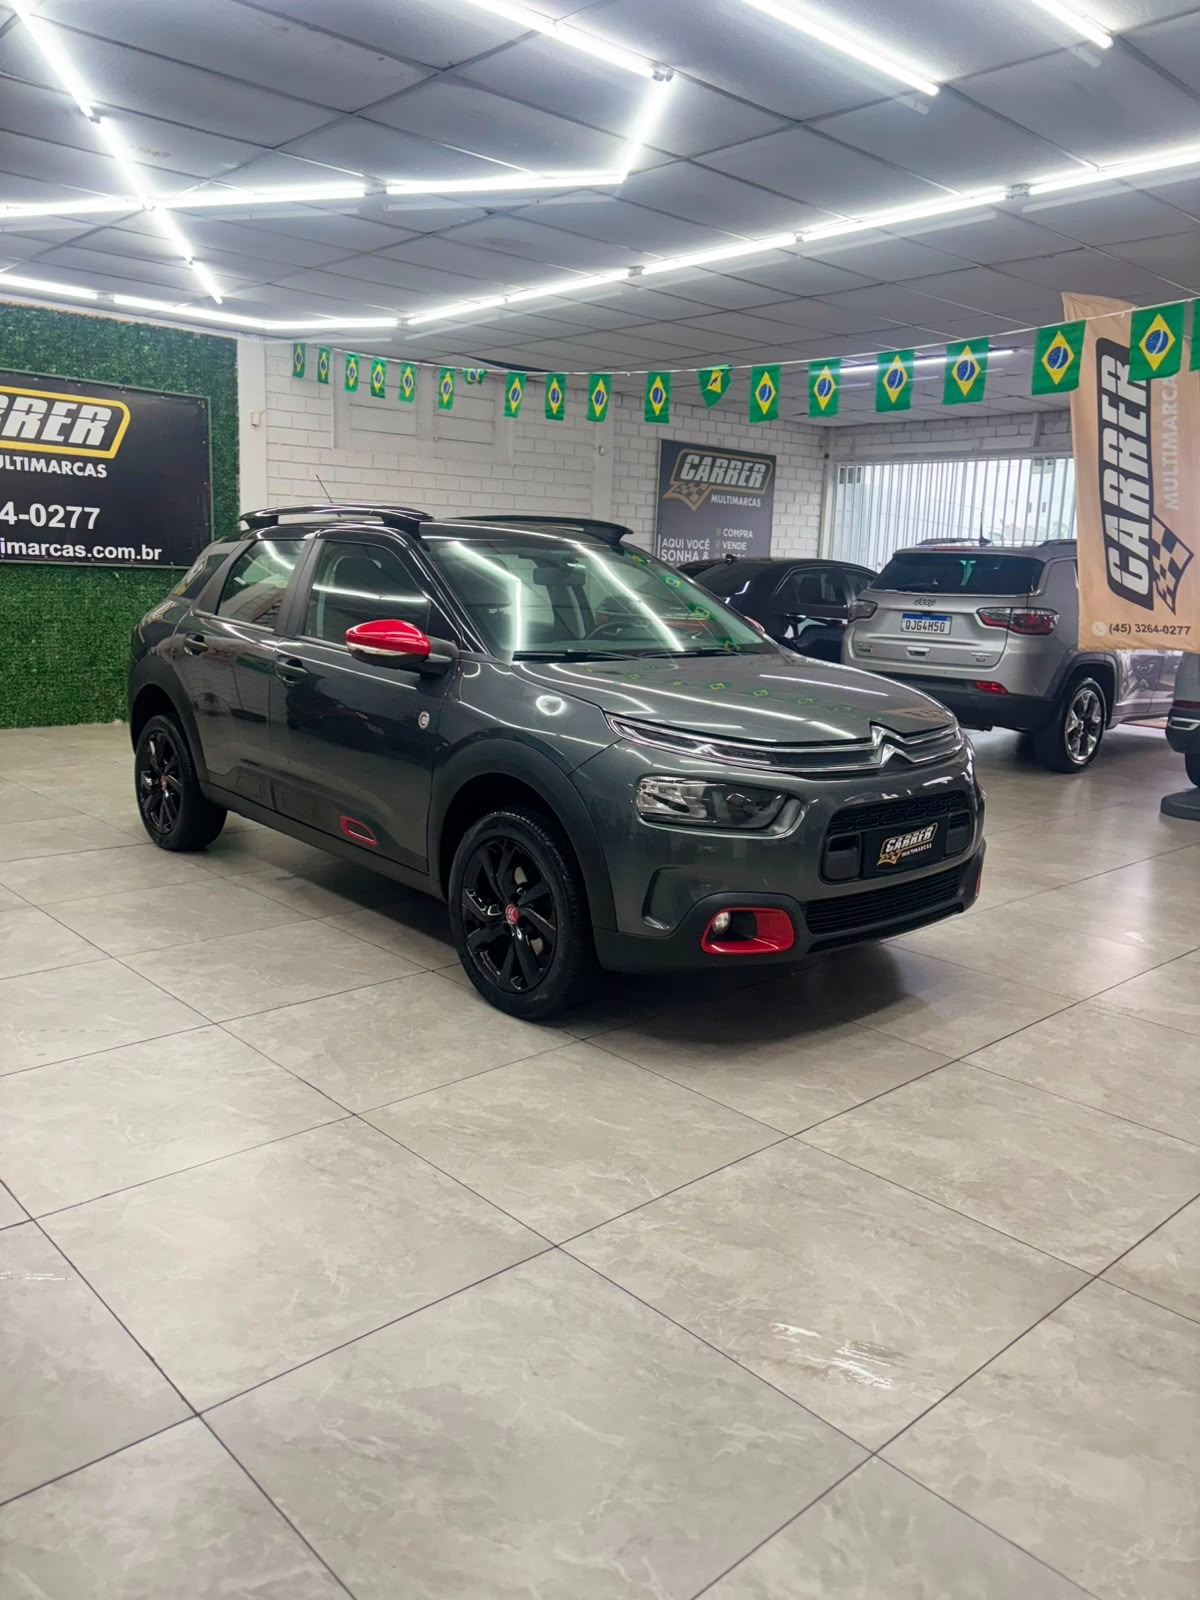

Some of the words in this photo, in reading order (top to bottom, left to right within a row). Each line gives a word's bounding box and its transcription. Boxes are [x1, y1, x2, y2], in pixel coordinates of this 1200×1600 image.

[0, 394, 112, 446] RER
[1161, 375, 1179, 512] MULTIMARCA
[680, 454, 766, 488] CARRER
[1101, 354, 1150, 596] CARRER
[711, 494, 761, 507] MULTIMARCAS
[0, 501, 101, 530] 4-0277
[722, 528, 754, 539] COMPRA
[661, 537, 684, 549] AQUI
[687, 538, 710, 550] VOCÊ
[722, 540, 747, 551] VENDE
[661, 549, 699, 561] SONHA
[703, 551, 709, 560] &
[1108, 623, 1132, 636] (45)
[1134, 624, 1192, 636] 3264-0277
